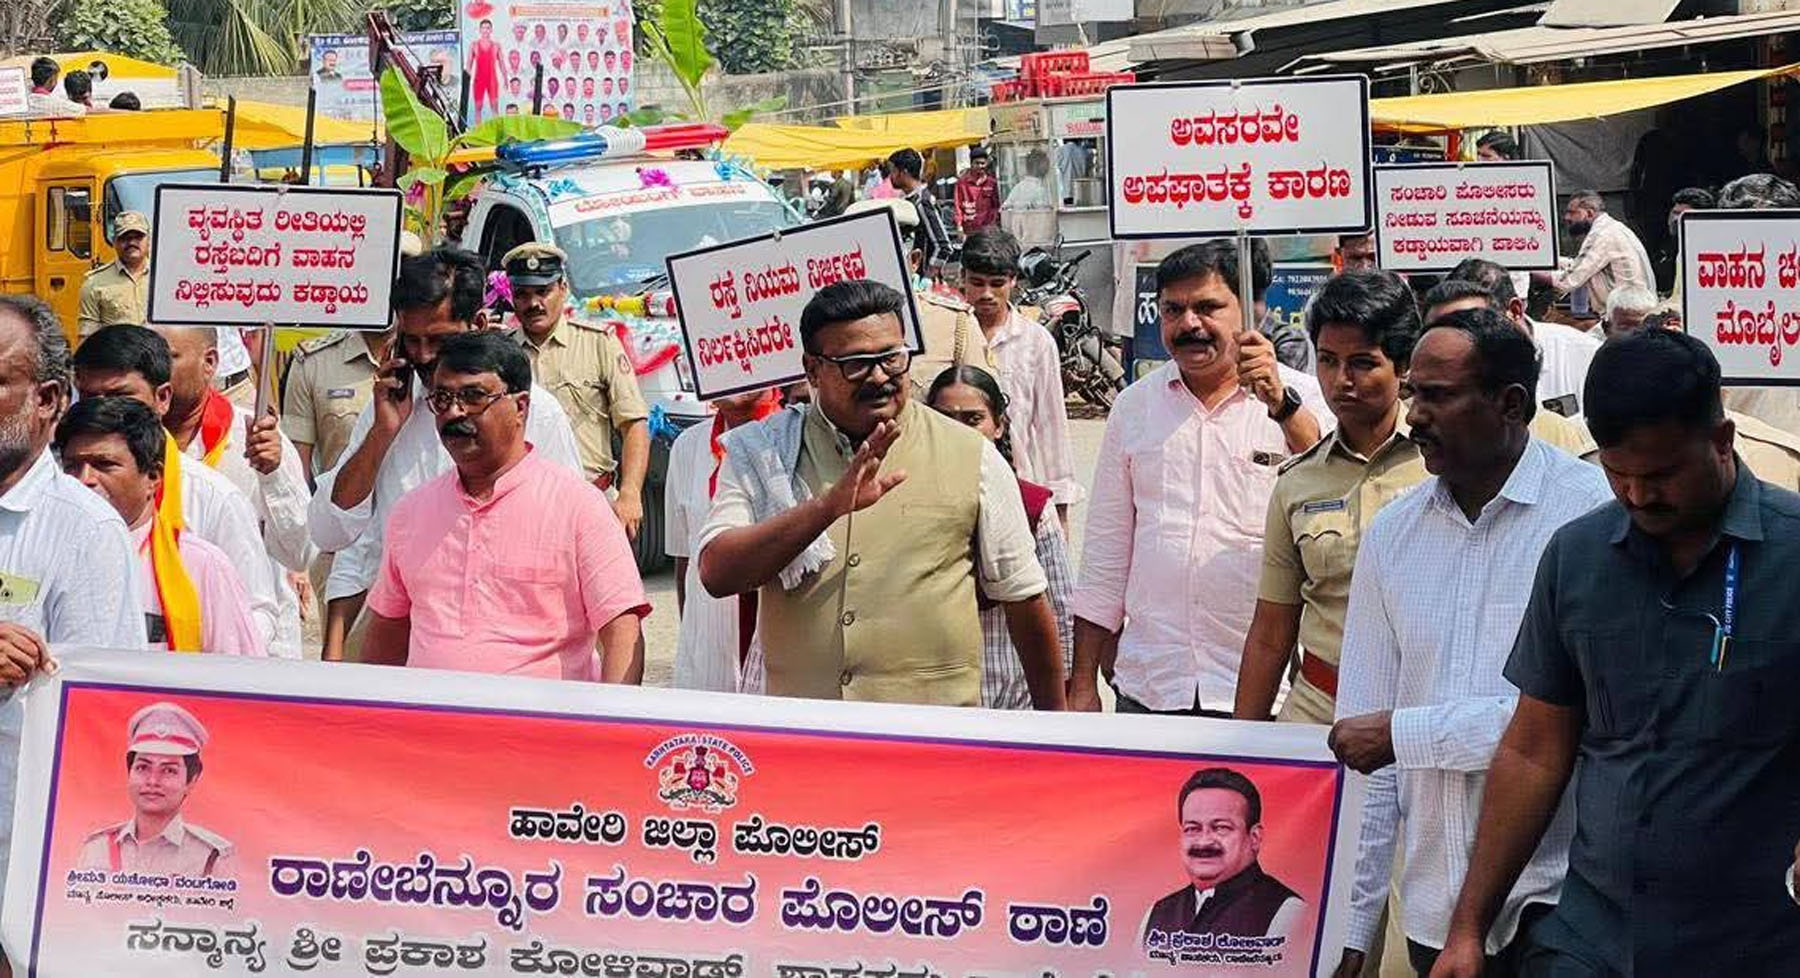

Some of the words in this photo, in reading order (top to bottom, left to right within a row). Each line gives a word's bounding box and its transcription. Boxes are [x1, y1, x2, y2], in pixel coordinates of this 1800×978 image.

[1171, 104, 1299, 146] ಅವಸರವೇ
[1123, 162, 1252, 219] ಅಪಘಾತಕ್ಕೆ
[1268, 160, 1350, 199] ಕಾರಣ
[1391, 185, 1447, 200] ಸಂಚಾರಿ
[189, 206, 263, 242] ವ್ಯವಸ್ಥಿತ
[275, 209, 366, 241] ರೀತಿಯಲ್ಲಿ
[1386, 211, 1437, 227] ನೀಡುವ
[195, 242, 280, 273] ರಸ್ತೆಬದಿಗೆ
[292, 245, 355, 268] ವಾಹನ
[1393, 237, 1483, 260] ಕಡ್ಡಾಯವಾಗಿ
[1492, 238, 1539, 251] ಪಾಲಿಸಿ
[1698, 241, 1766, 288] ವಾಹನ
[175, 279, 281, 309] ನಿಲ್ಲಿಸುವುದು
[293, 281, 368, 314] ಕಡ್ಡಾಯ
[709, 270, 742, 319] ರಸ್ತೆ
[744, 260, 800, 302] ನಿಯಮ
[702, 736, 728, 751] STATE
[729, 747, 754, 773] POLICE
[511, 806, 624, 843] ಹಾವೇರಿ
[644, 817, 717, 862] ಜಿಲ್ಲಾ
[735, 816, 878, 859] ಪೊಲೀಸ್
[271, 850, 561, 931] ರಾಣೇಬೆನ್ನೂರ
[586, 867, 756, 922] ಸಂಚಾರ
[782, 879, 982, 937] ಪೊಲೀಸ್
[1009, 897, 1108, 945] ಠಾಣೆ
[127, 919, 266, 973] ಸನ್ಮಾನ್ಯ
[287, 928, 341, 971] ಶ್ರೀ
[366, 932, 486, 976] ಪ್ರಕಾಶ
